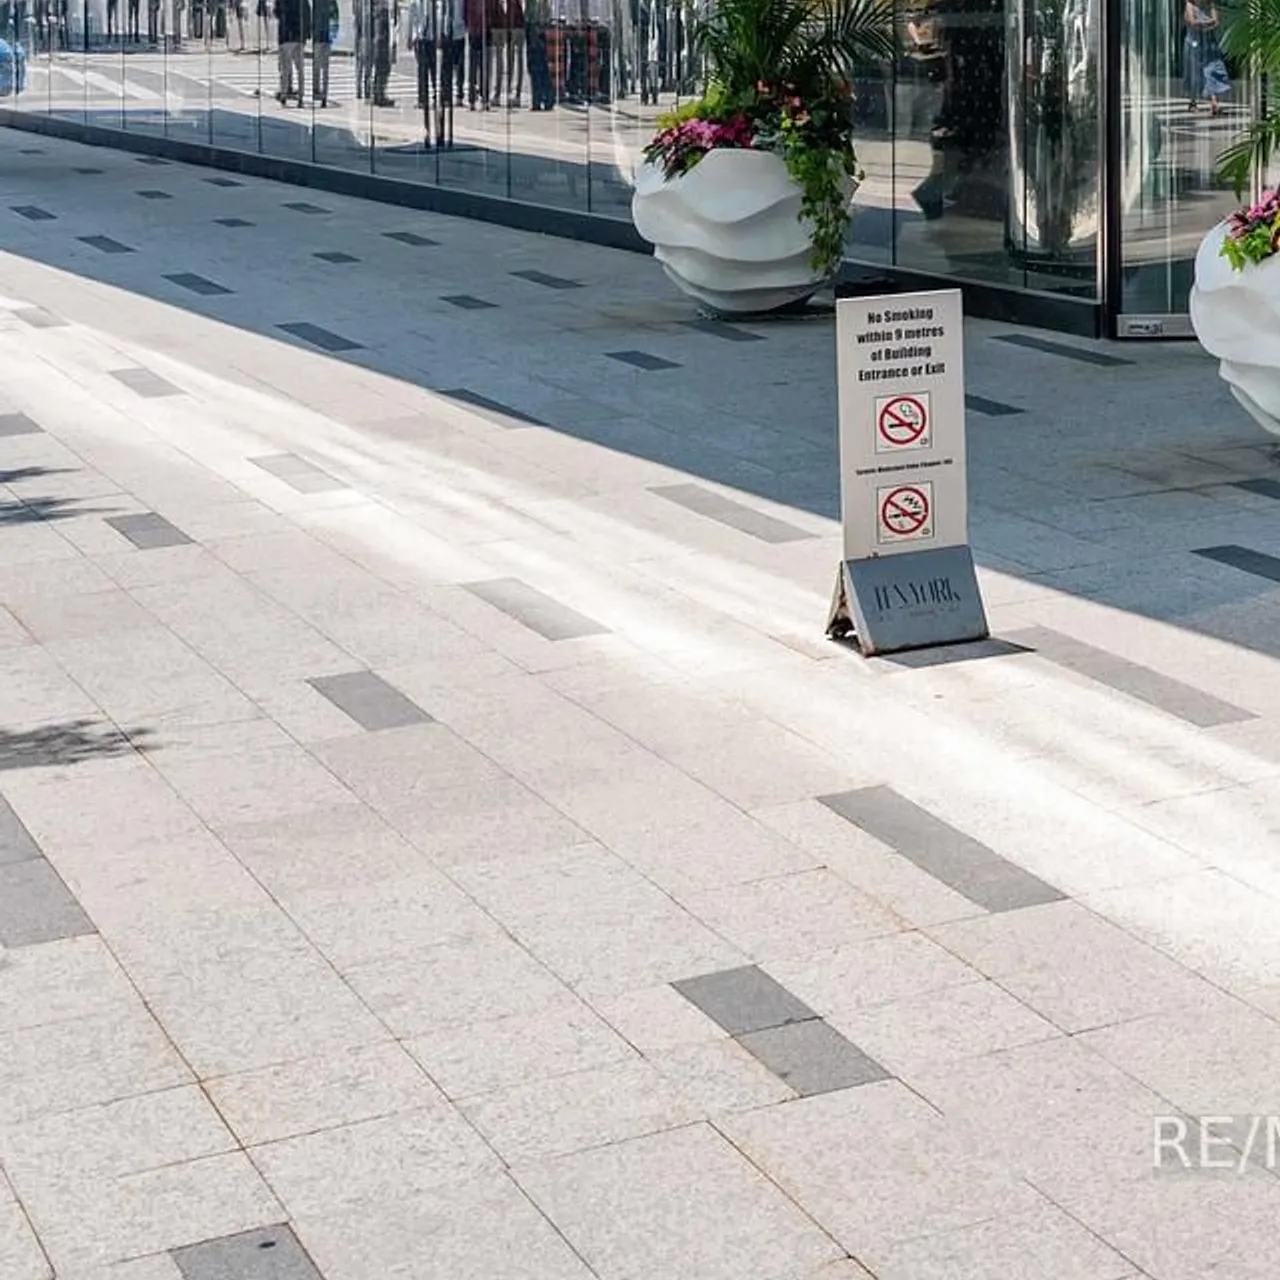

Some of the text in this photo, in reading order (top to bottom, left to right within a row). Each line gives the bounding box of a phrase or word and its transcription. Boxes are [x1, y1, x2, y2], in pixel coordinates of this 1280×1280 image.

[867, 308, 933, 324] No Smoking
[857, 327, 944, 343] within 9 metres
[870, 346, 931, 362] of Building
[859, 363, 945, 381] Entrance or Exit
